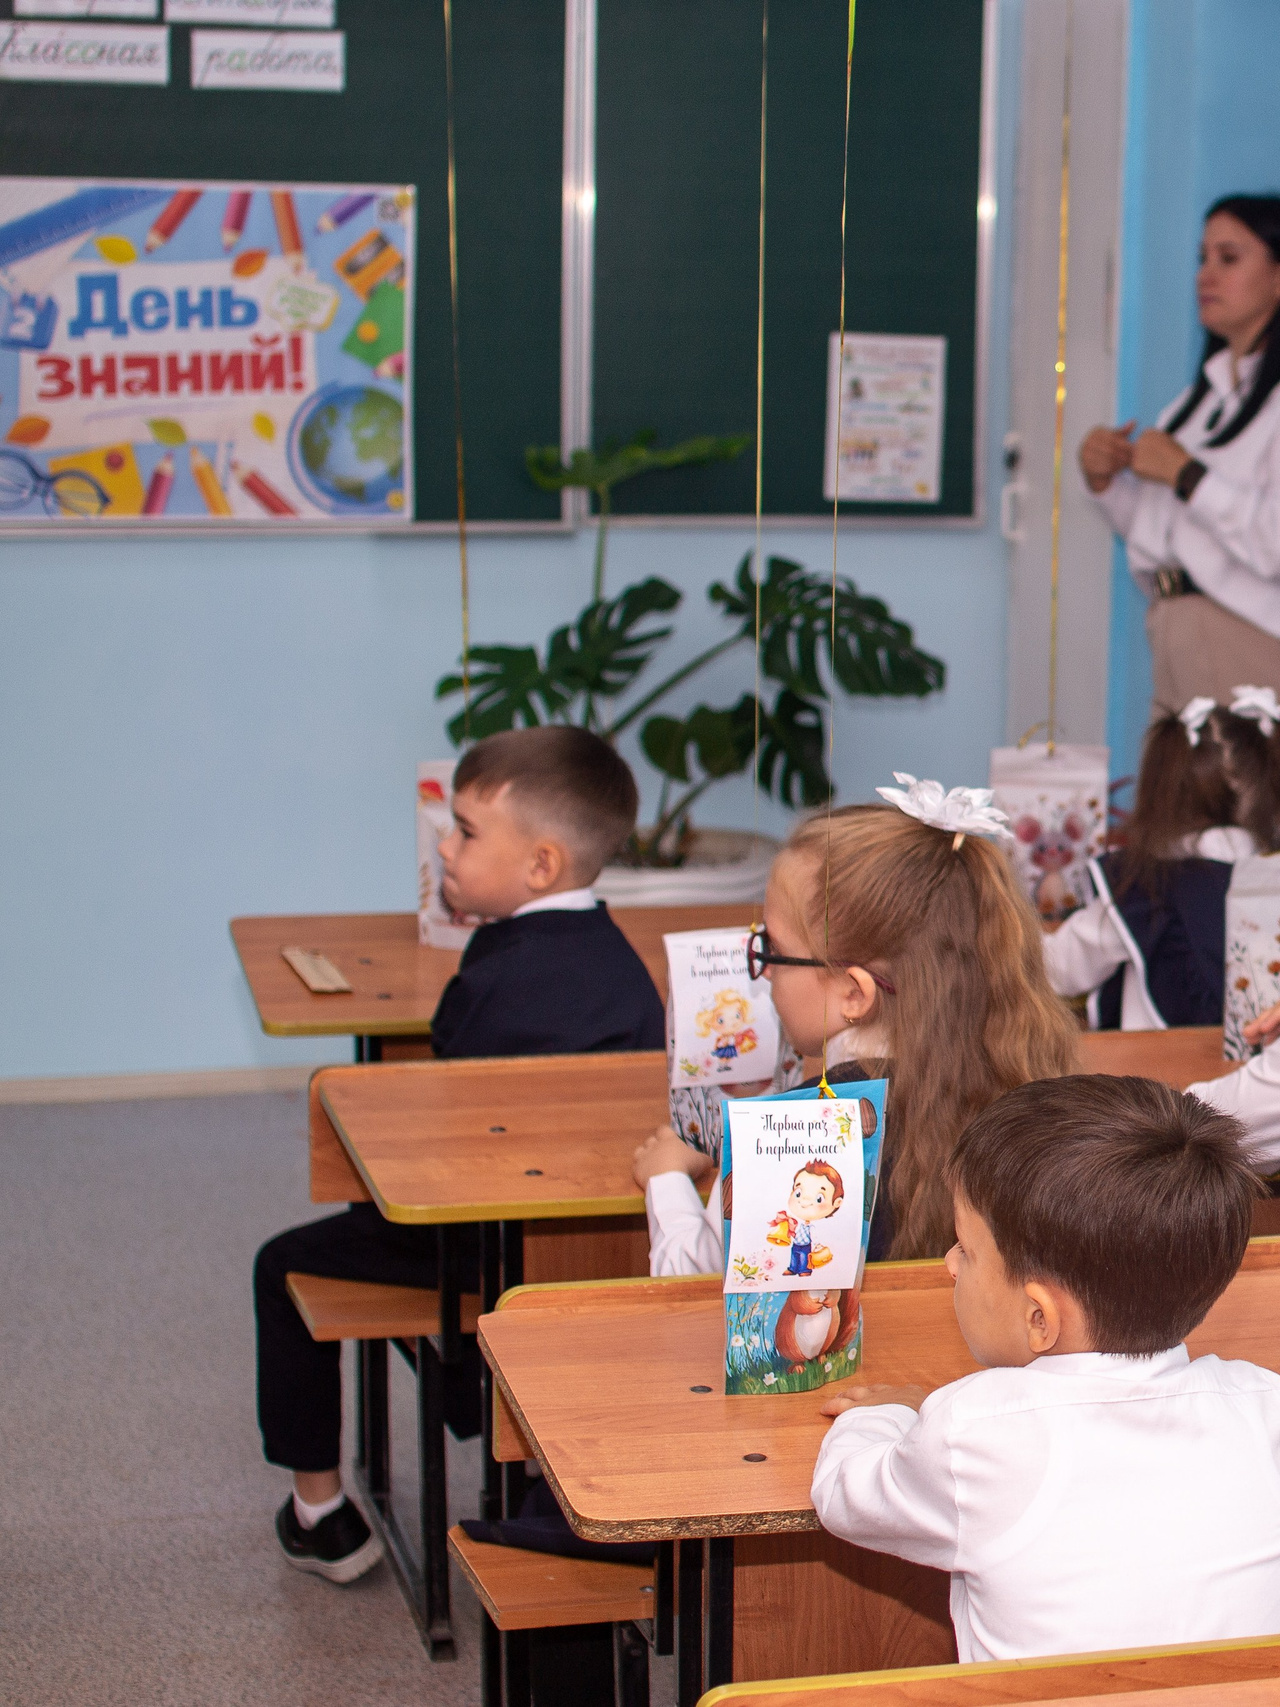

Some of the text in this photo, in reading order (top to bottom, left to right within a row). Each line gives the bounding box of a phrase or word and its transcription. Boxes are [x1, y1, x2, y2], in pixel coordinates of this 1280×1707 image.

[68, 272, 260, 339] День
[36, 331, 306, 400] знаний!
[760, 1113, 829, 1138] Первый раз
[756, 1137, 838, 1162] в первый класс
